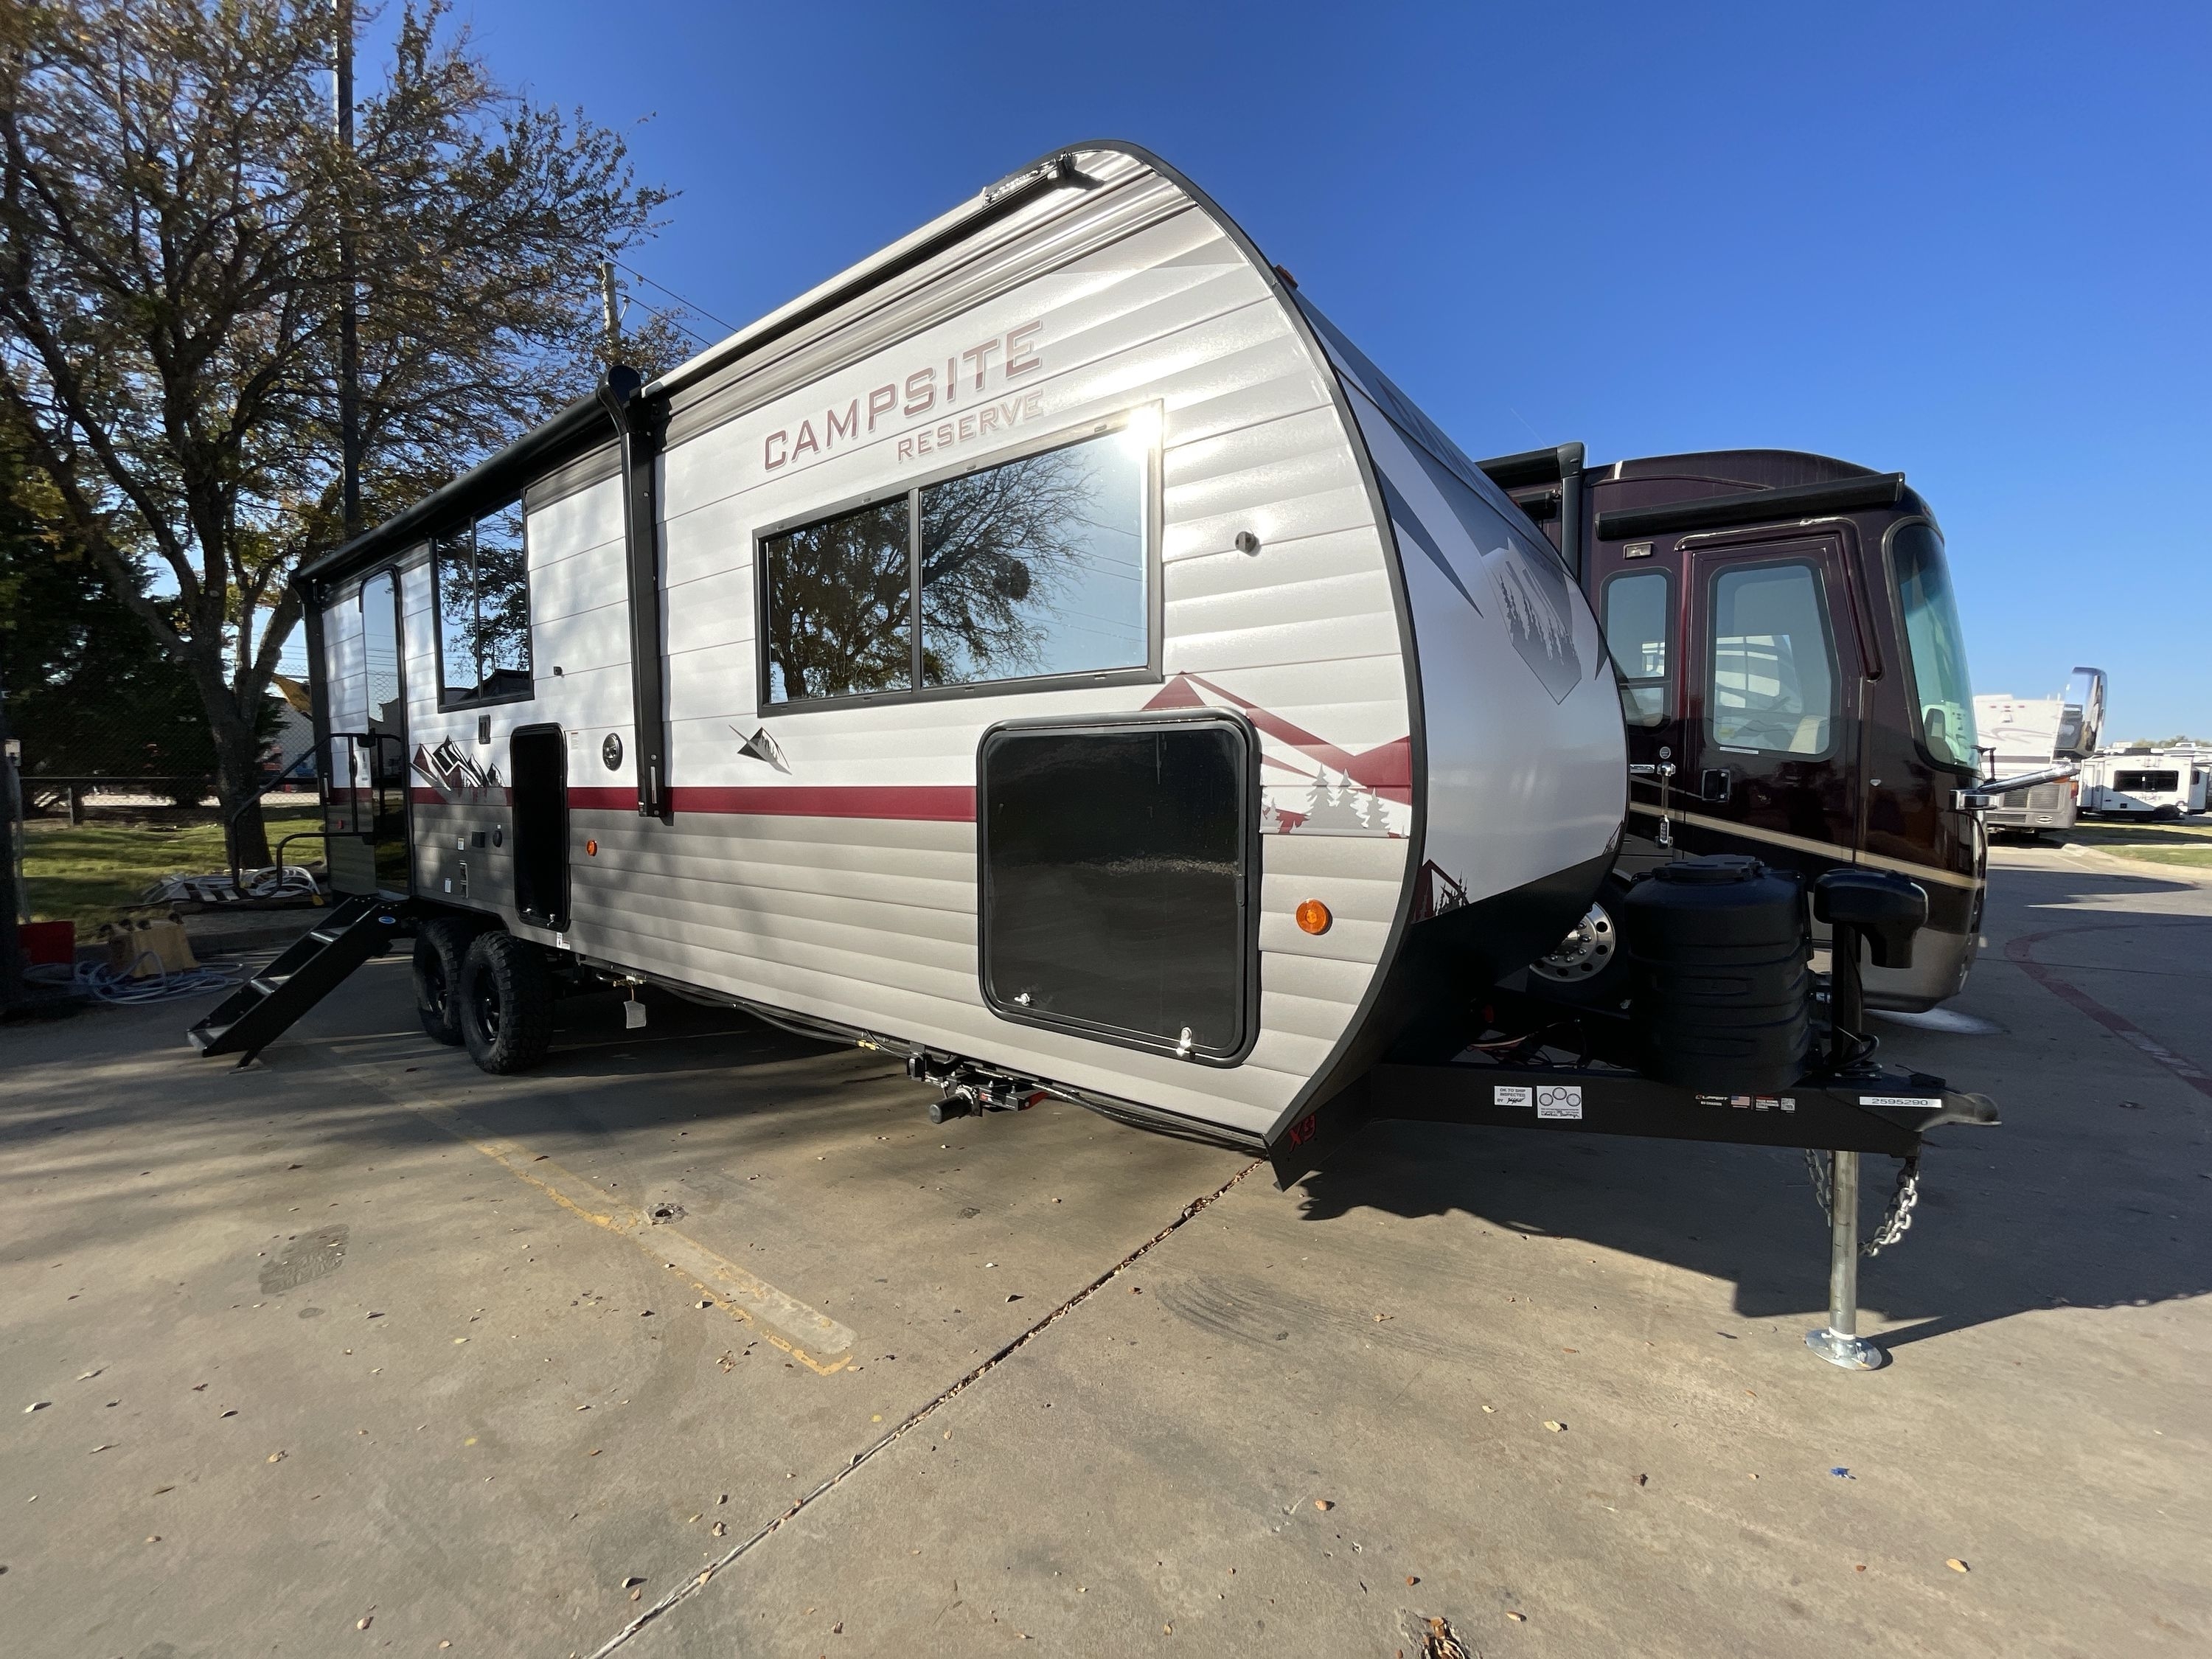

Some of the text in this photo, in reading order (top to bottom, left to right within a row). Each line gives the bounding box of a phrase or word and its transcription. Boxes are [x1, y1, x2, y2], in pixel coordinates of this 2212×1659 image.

[764, 319, 1043, 471] CAMPSITE
[897, 389, 1044, 462] RESERVE
[1871, 1097, 1929, 1106] 2595290
